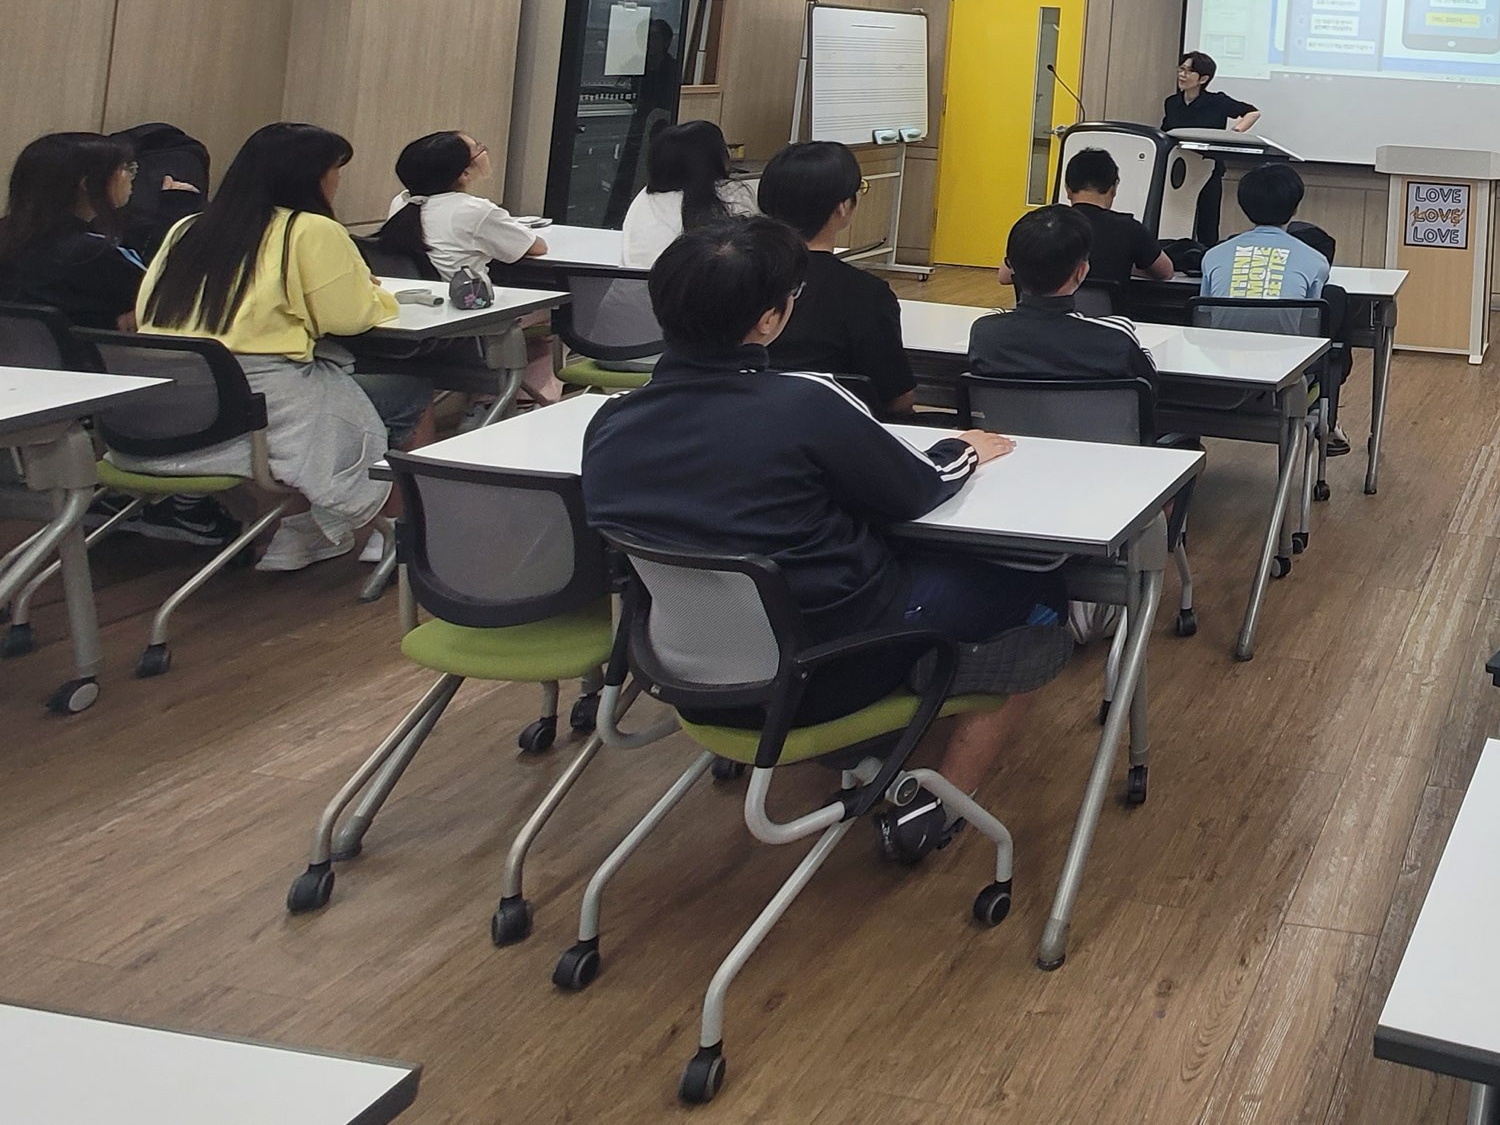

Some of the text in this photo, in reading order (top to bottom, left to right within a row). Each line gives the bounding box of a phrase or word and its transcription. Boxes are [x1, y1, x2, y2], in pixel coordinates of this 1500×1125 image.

[1415, 186, 1462, 204] LOVE
[1413, 206, 1462, 224] LOVE
[1412, 226, 1460, 245] LOVE
[1229, 245, 1254, 299] THINK
[1246, 246, 1272, 299] MOVE
